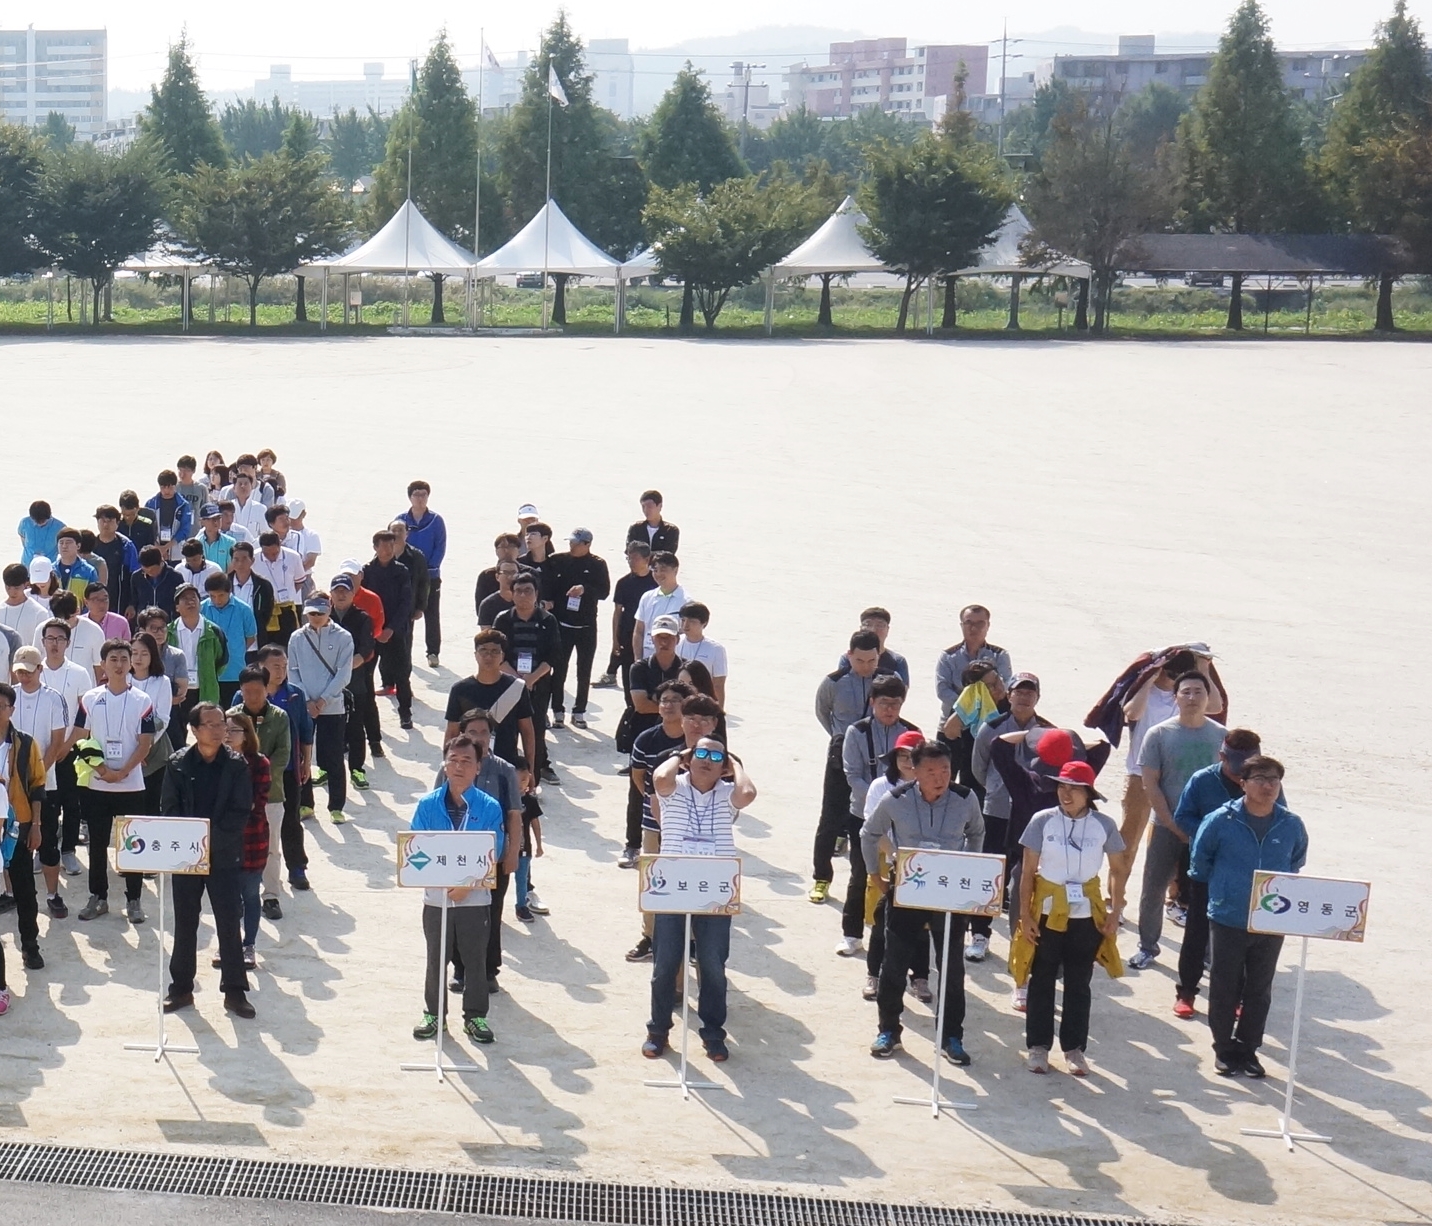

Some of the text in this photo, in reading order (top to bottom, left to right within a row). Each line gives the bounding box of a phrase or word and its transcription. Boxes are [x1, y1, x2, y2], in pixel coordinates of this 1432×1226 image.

[151, 840, 199, 853] 충주시
[436, 854, 487, 867] 제천시
[677, 880, 730, 893] 보은군
[937, 875, 992, 892] 옥천군
[1298, 900, 1358, 918] 영동군
